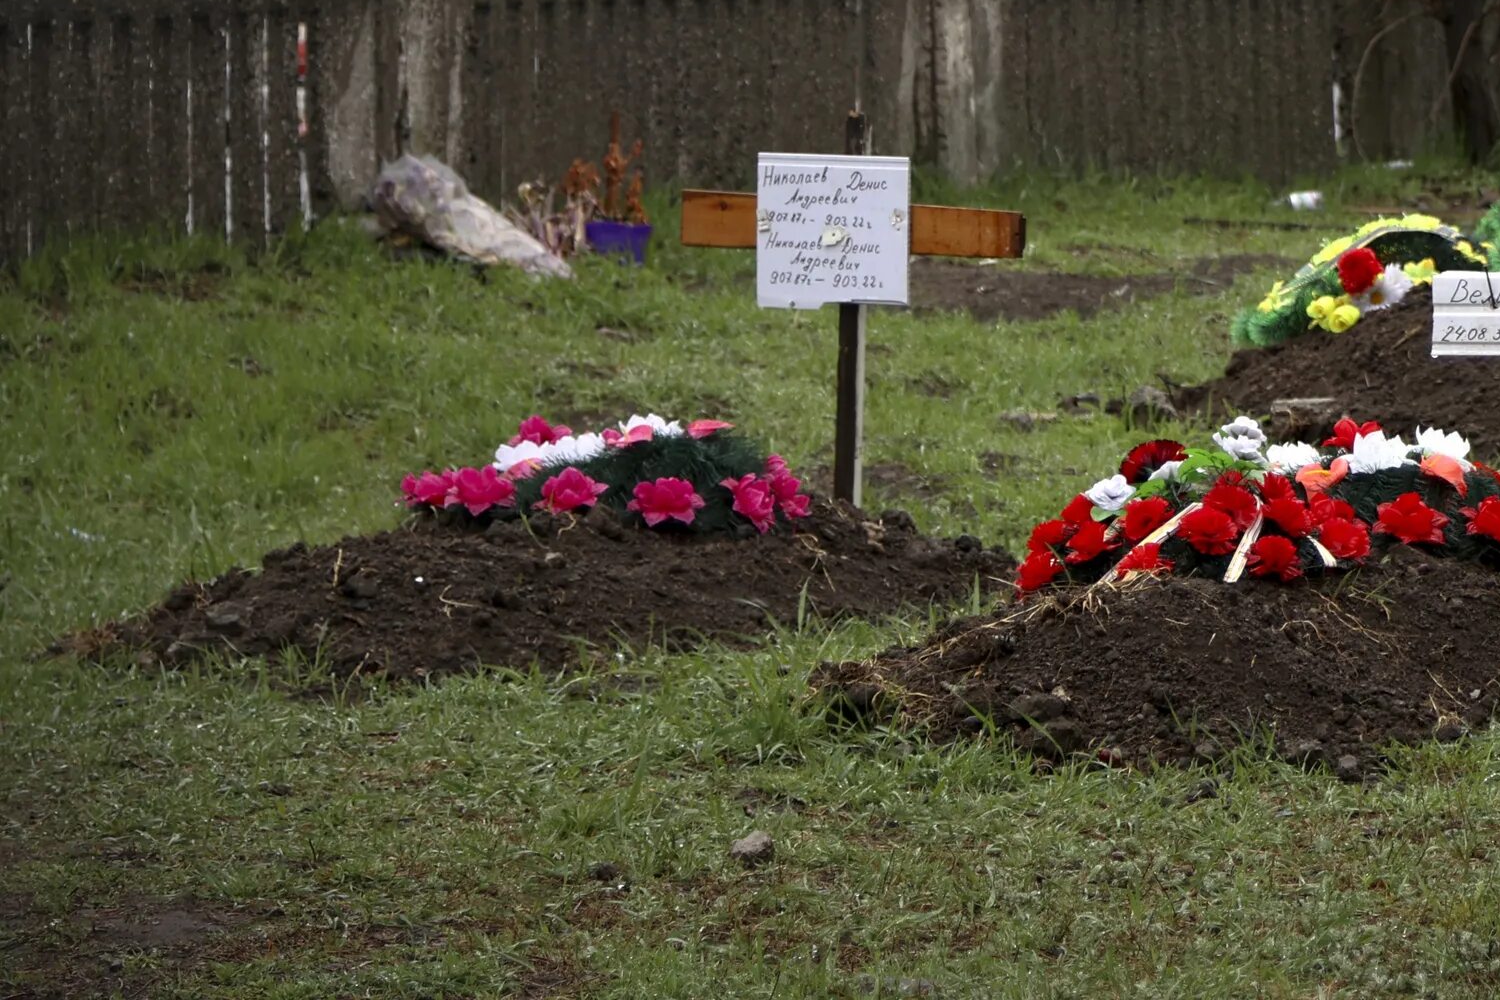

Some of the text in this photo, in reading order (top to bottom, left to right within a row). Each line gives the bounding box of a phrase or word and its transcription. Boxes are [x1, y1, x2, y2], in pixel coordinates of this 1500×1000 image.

[763, 165, 888, 190] Николаев Денис
[785, 188, 858, 209] Андреевич
[766, 232, 880, 254] Николаев Денис
[790, 252, 860, 273] Андреевич
